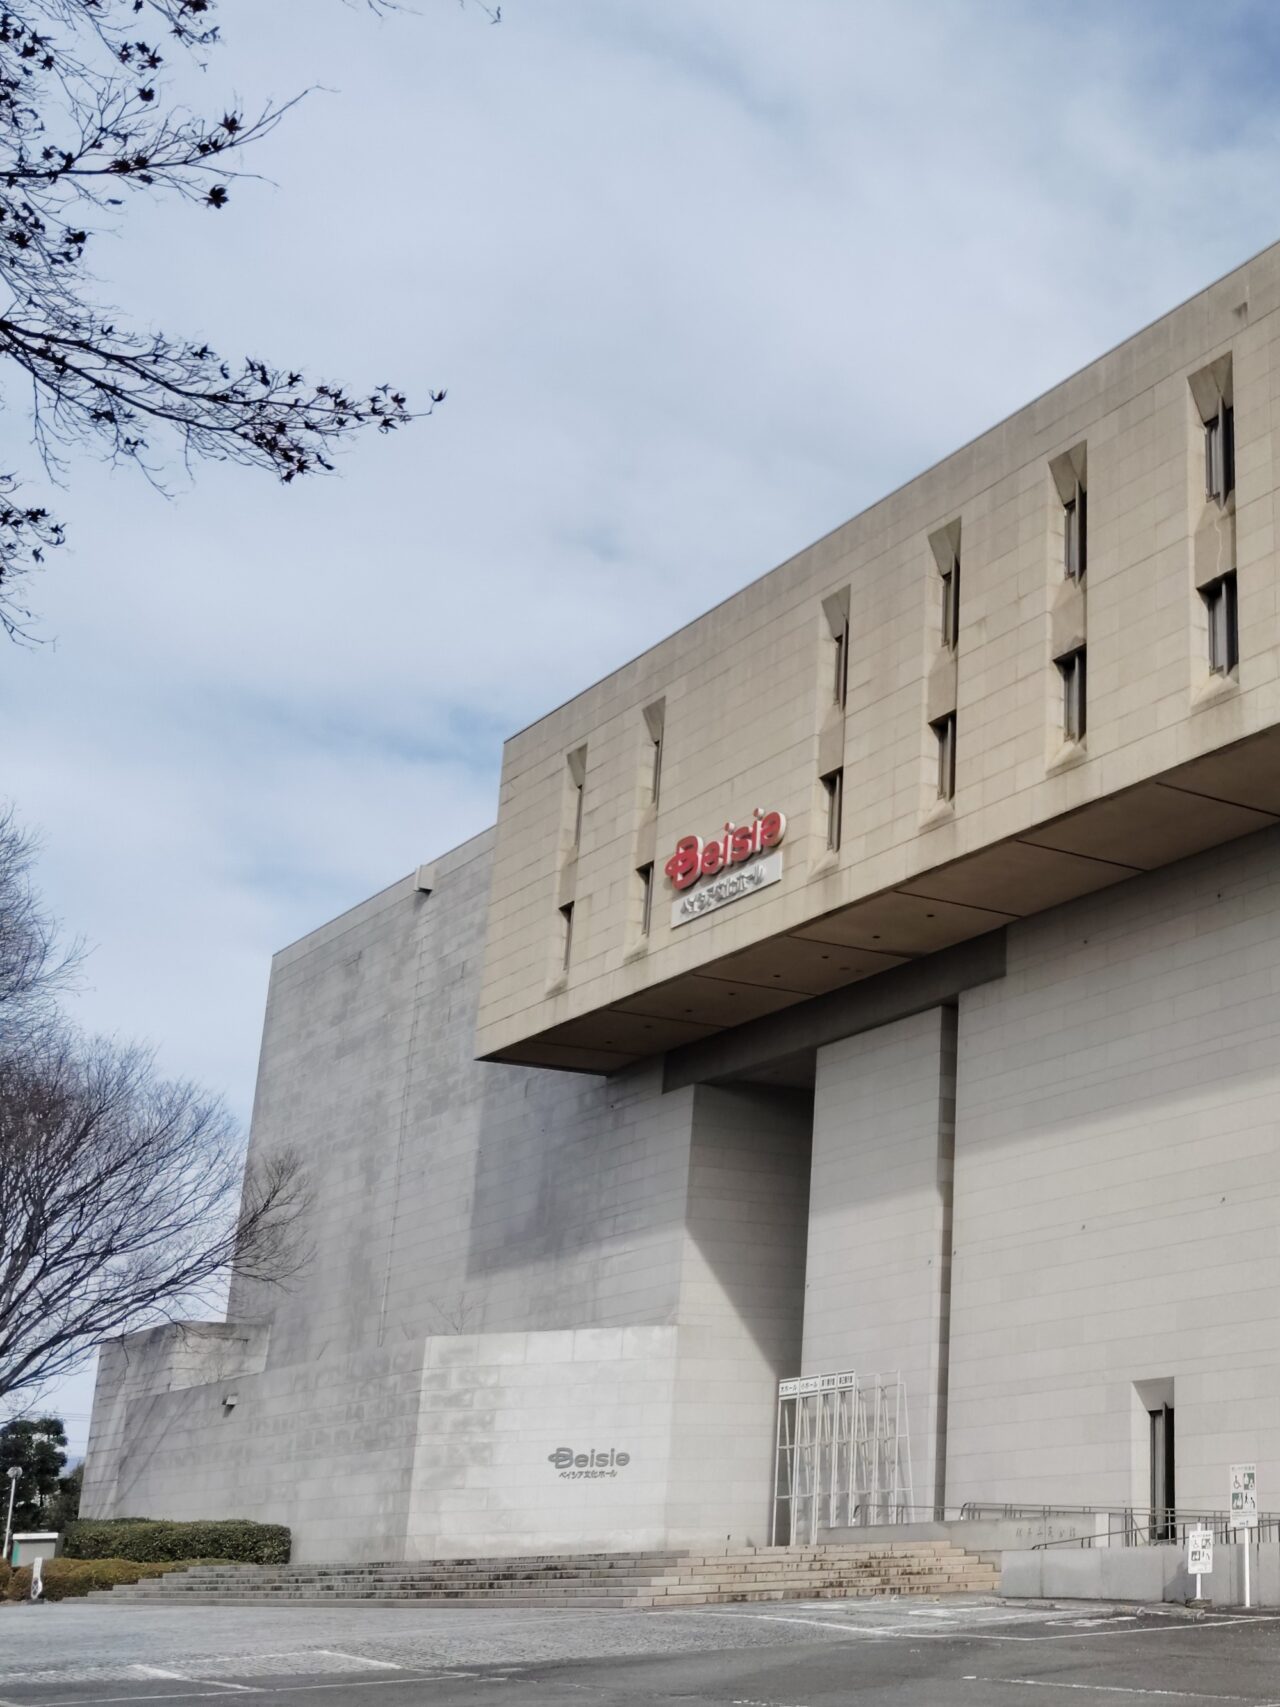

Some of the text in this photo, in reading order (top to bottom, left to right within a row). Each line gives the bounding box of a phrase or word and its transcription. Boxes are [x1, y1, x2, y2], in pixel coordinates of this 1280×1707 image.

[558, 1469, 618, 1480] ベイシア文化ホール
